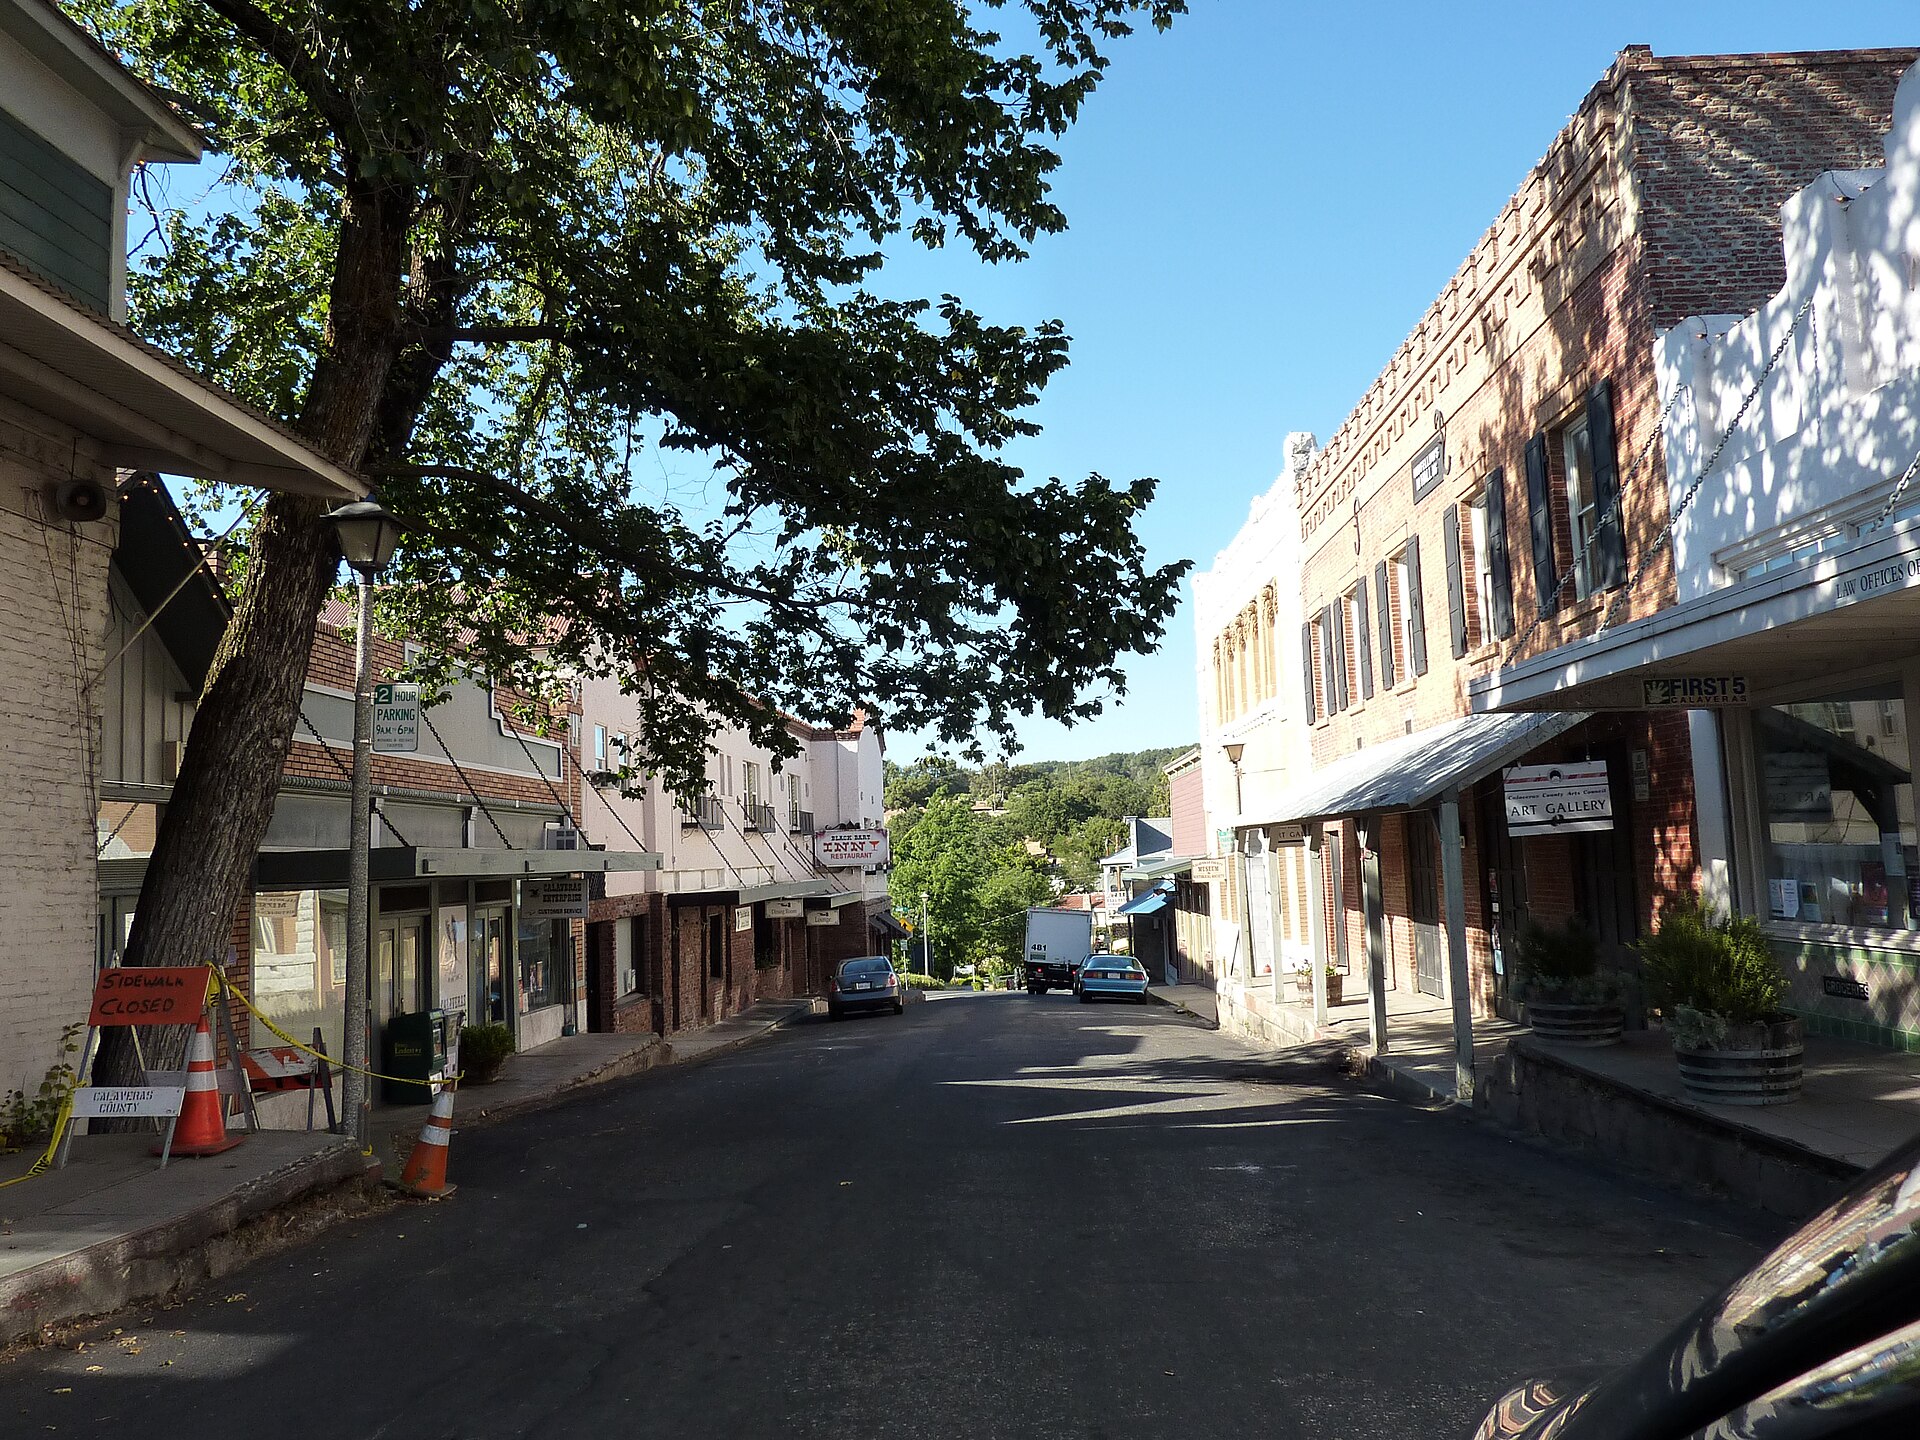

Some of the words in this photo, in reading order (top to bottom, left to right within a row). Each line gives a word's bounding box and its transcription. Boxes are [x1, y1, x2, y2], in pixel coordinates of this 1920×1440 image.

[1836, 579, 1857, 598] LAW
[1860, 563, 1904, 592] OFFICES
[1670, 677, 1729, 696] FIRST
[1732, 676, 1746, 695] 5
[378, 686, 389, 702] 2
[394, 691, 417, 701] HOUR
[1670, 695, 1747, 704] CALAVERAS
[377, 708, 416, 721] PARKING
[1511, 804, 1537, 817] ART
[1545, 799, 1606, 814] GALLERY
[823, 841, 866, 852] INN
[831, 852, 873, 860] RESTAURANT
[543, 883, 582, 892] CALAVERAS
[542, 893, 582, 903] ENTERPRISE
[1031, 943, 1047, 952] 481
[102, 973, 184, 989] SIDEWALK
[100, 998, 174, 1015] CLOSED
[93, 1090, 154, 1101] CALAVERAS
[99, 1102, 140, 1113] COUNTY
